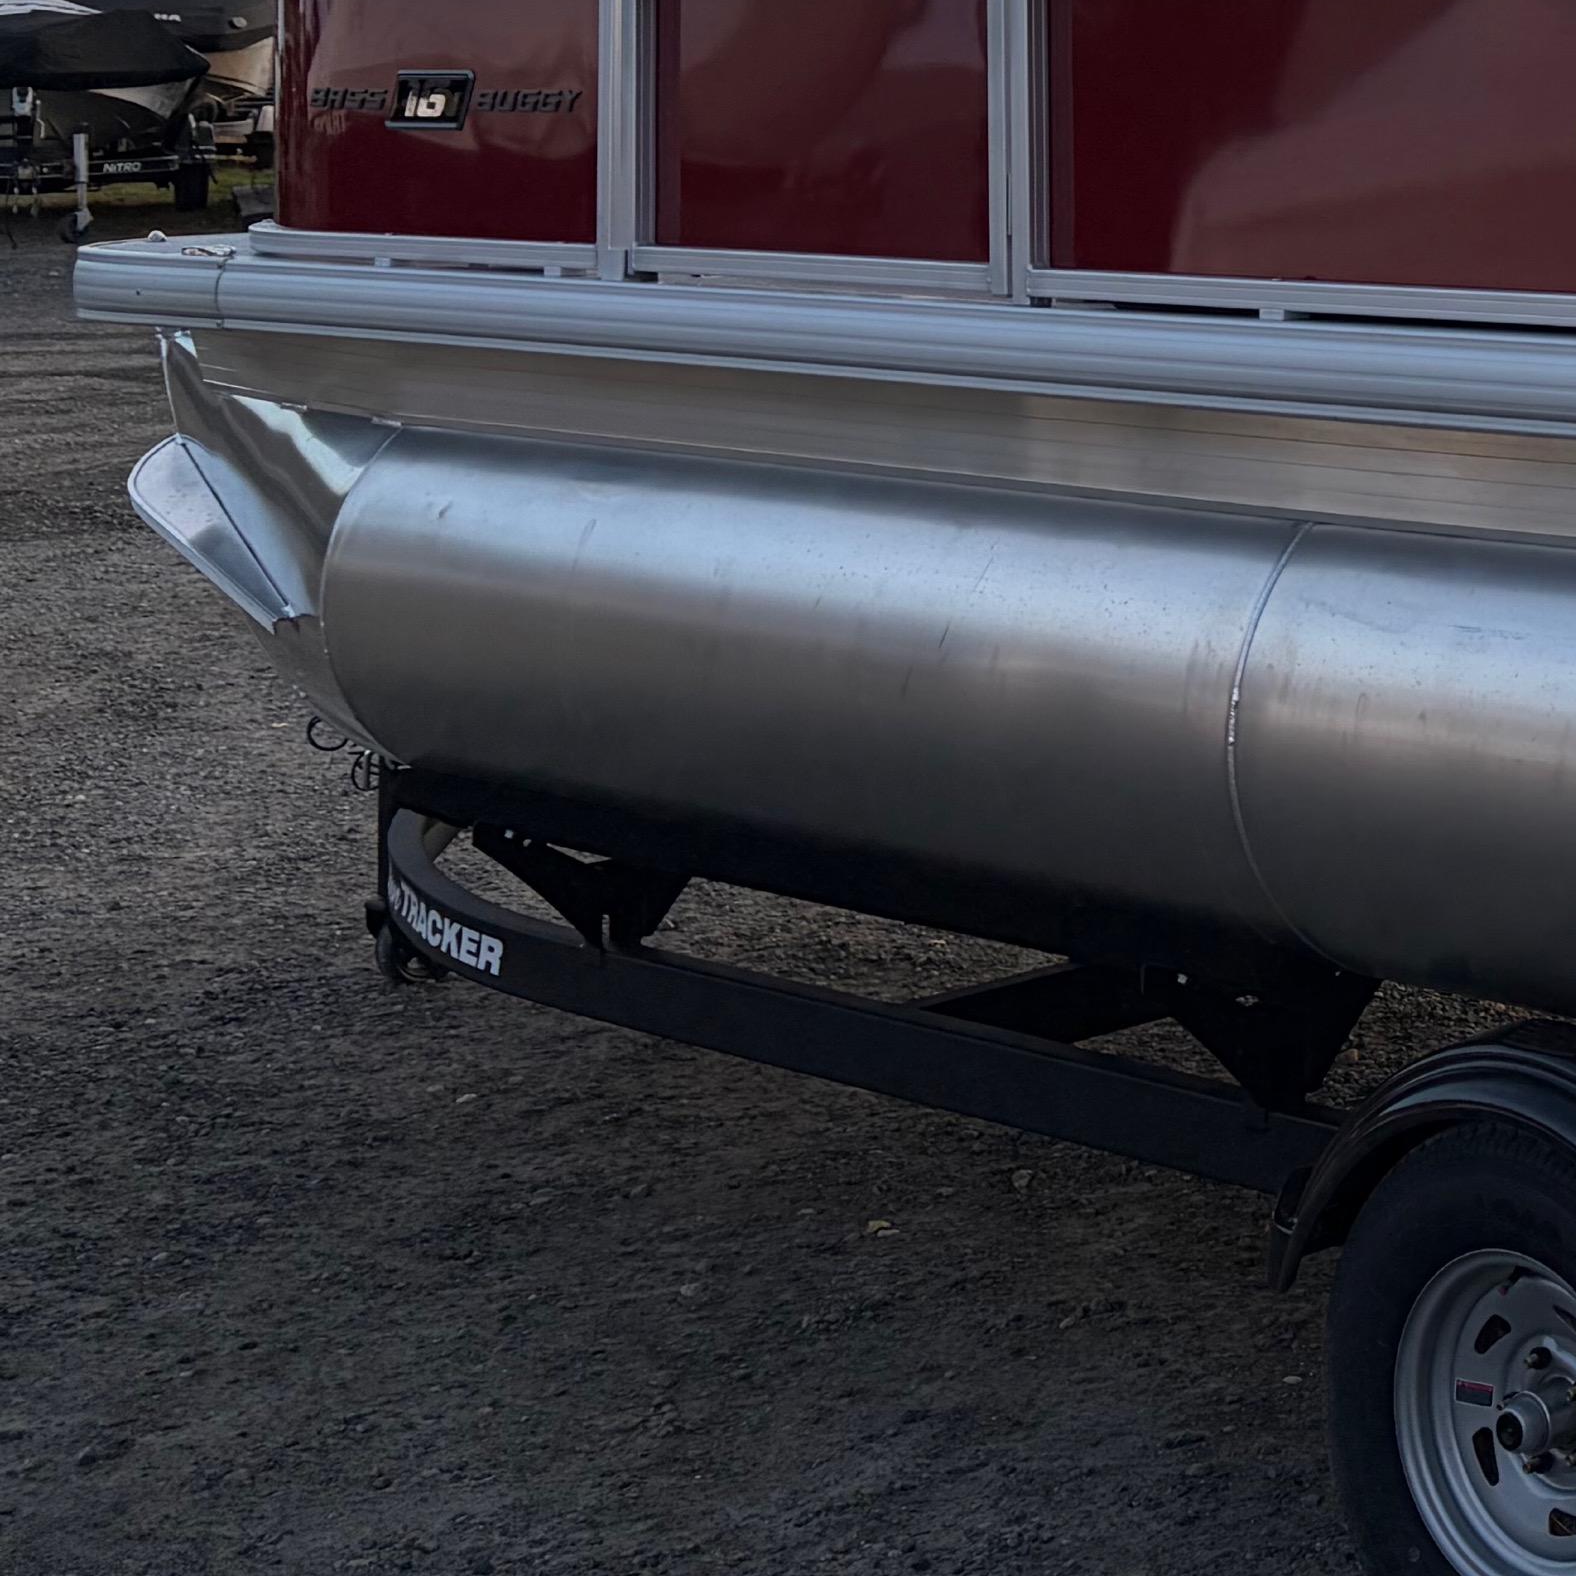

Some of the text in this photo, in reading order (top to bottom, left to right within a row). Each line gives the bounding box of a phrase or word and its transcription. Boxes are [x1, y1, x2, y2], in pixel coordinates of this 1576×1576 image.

[311, 80, 584, 117] BASS 16 BUGGY
[400, 881, 504, 976] TRACKER
